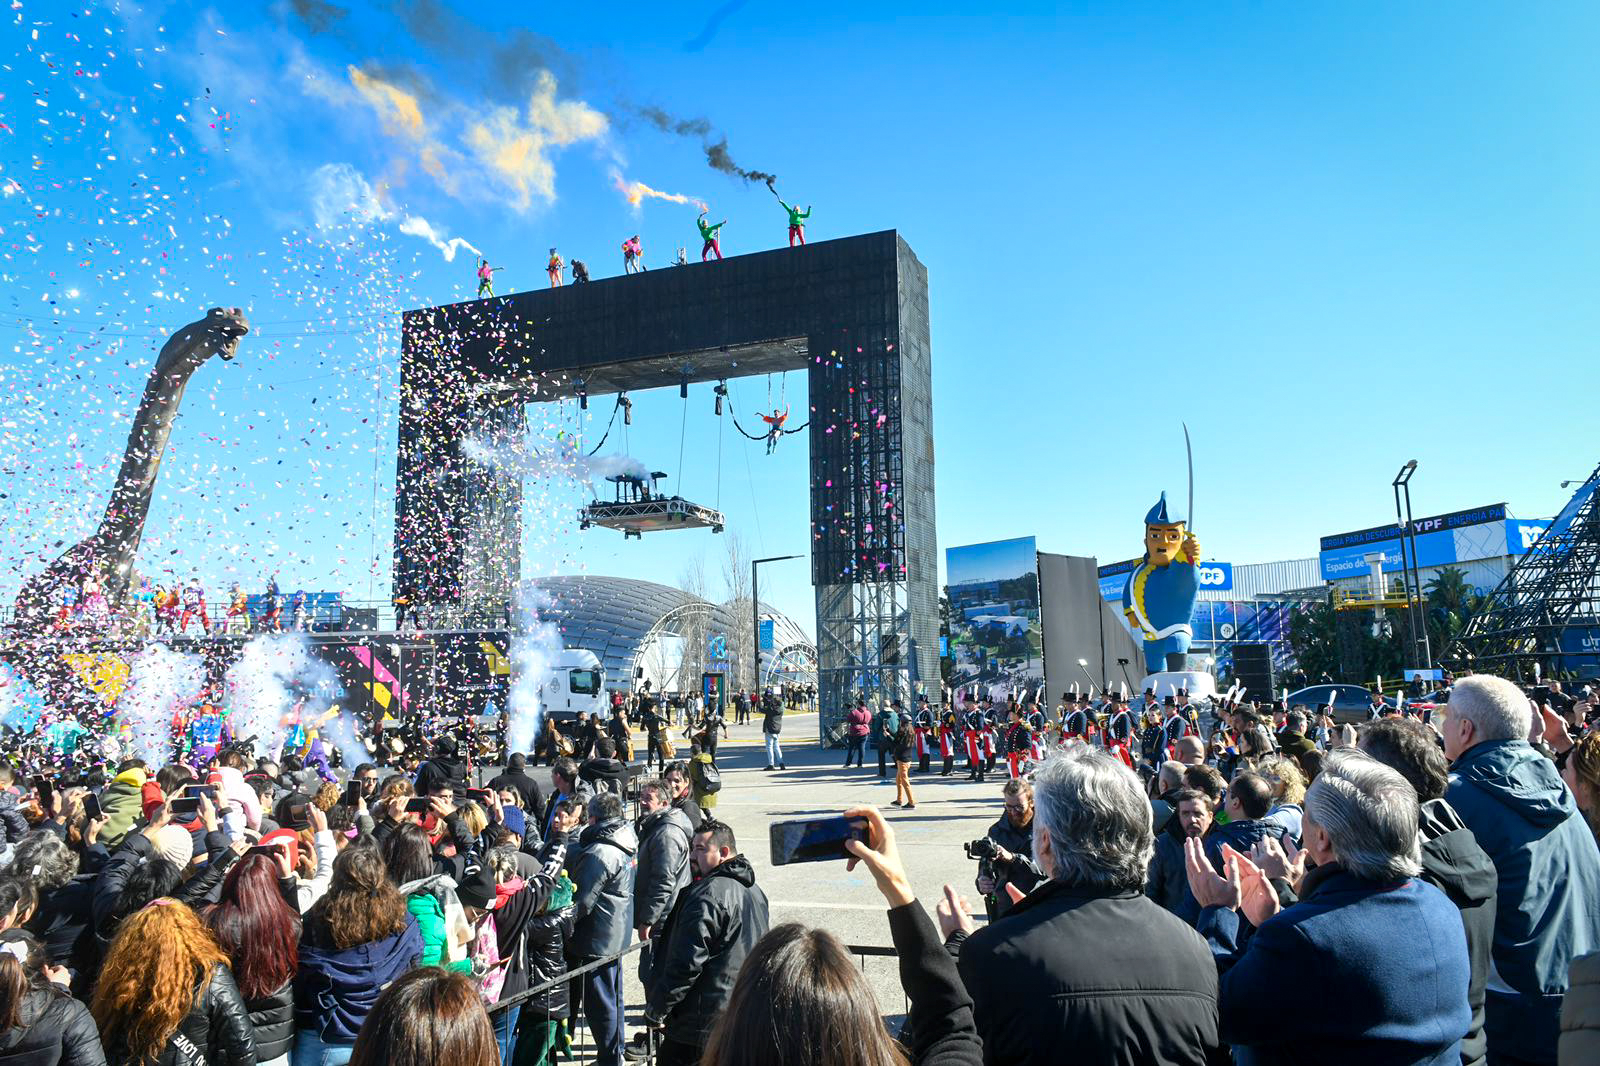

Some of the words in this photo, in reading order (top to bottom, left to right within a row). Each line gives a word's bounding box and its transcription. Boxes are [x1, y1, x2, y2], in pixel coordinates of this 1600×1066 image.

[1414, 518, 1443, 532] YPF
[1326, 560, 1353, 573] Espacio
[1354, 557, 1364, 568] de
[173, 1034, 198, 1058] LOVE
